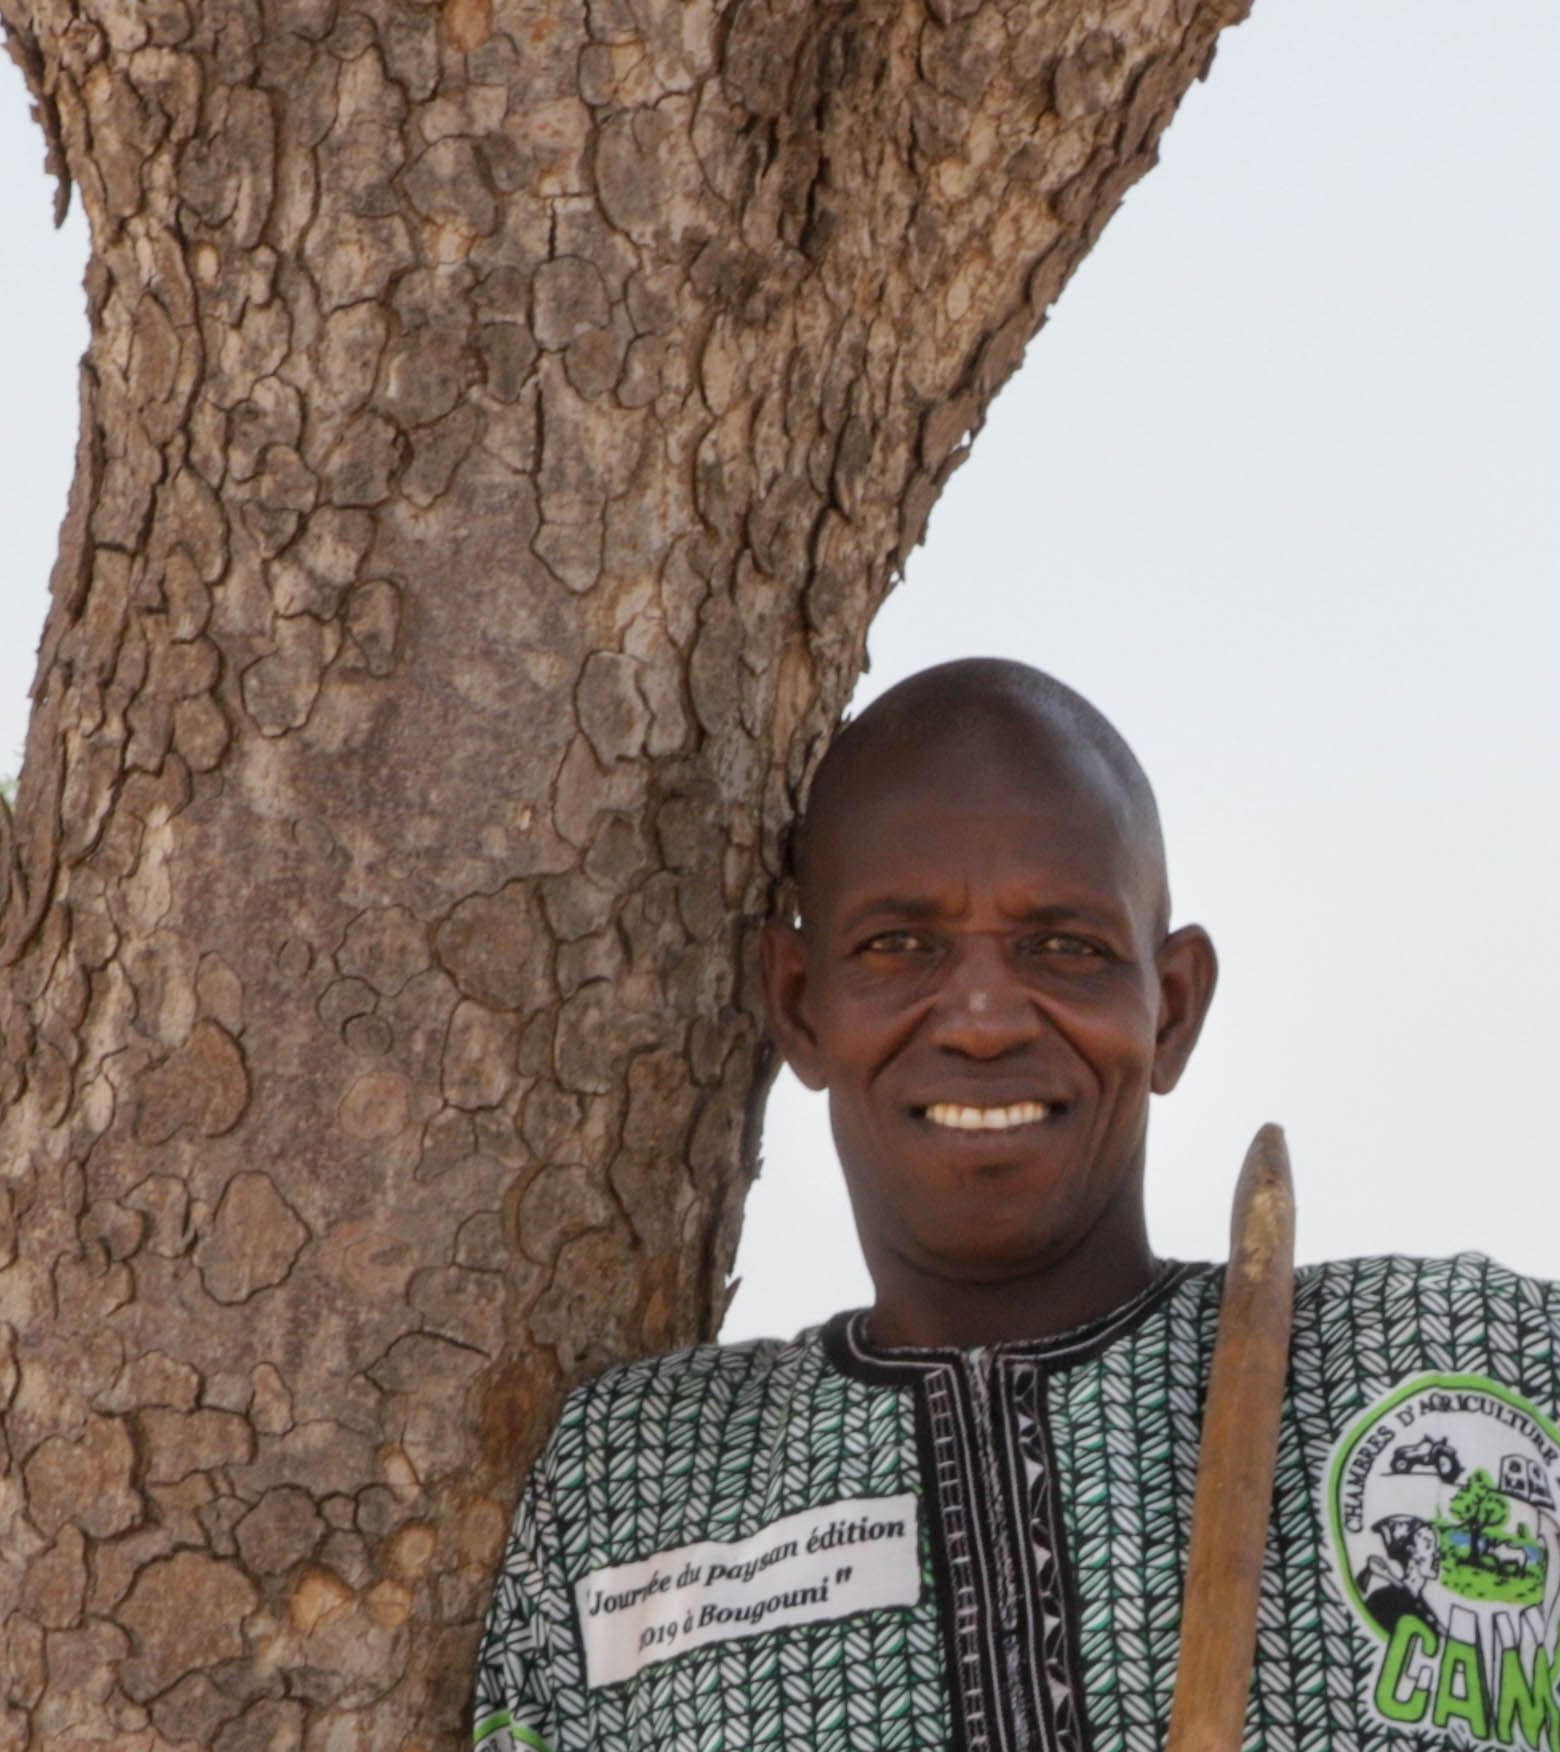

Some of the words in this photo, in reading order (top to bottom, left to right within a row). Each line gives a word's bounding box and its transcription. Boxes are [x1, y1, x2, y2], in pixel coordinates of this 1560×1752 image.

[1343, 1425, 1396, 1534] CHAMBRES
[1395, 1391, 1560, 1467] D'AGRICULTURE
[676, 1562, 702, 1590] du
[705, 1539, 798, 1586] paysan
[805, 1517, 906, 1552] édition
[682, 1609, 694, 1634] à
